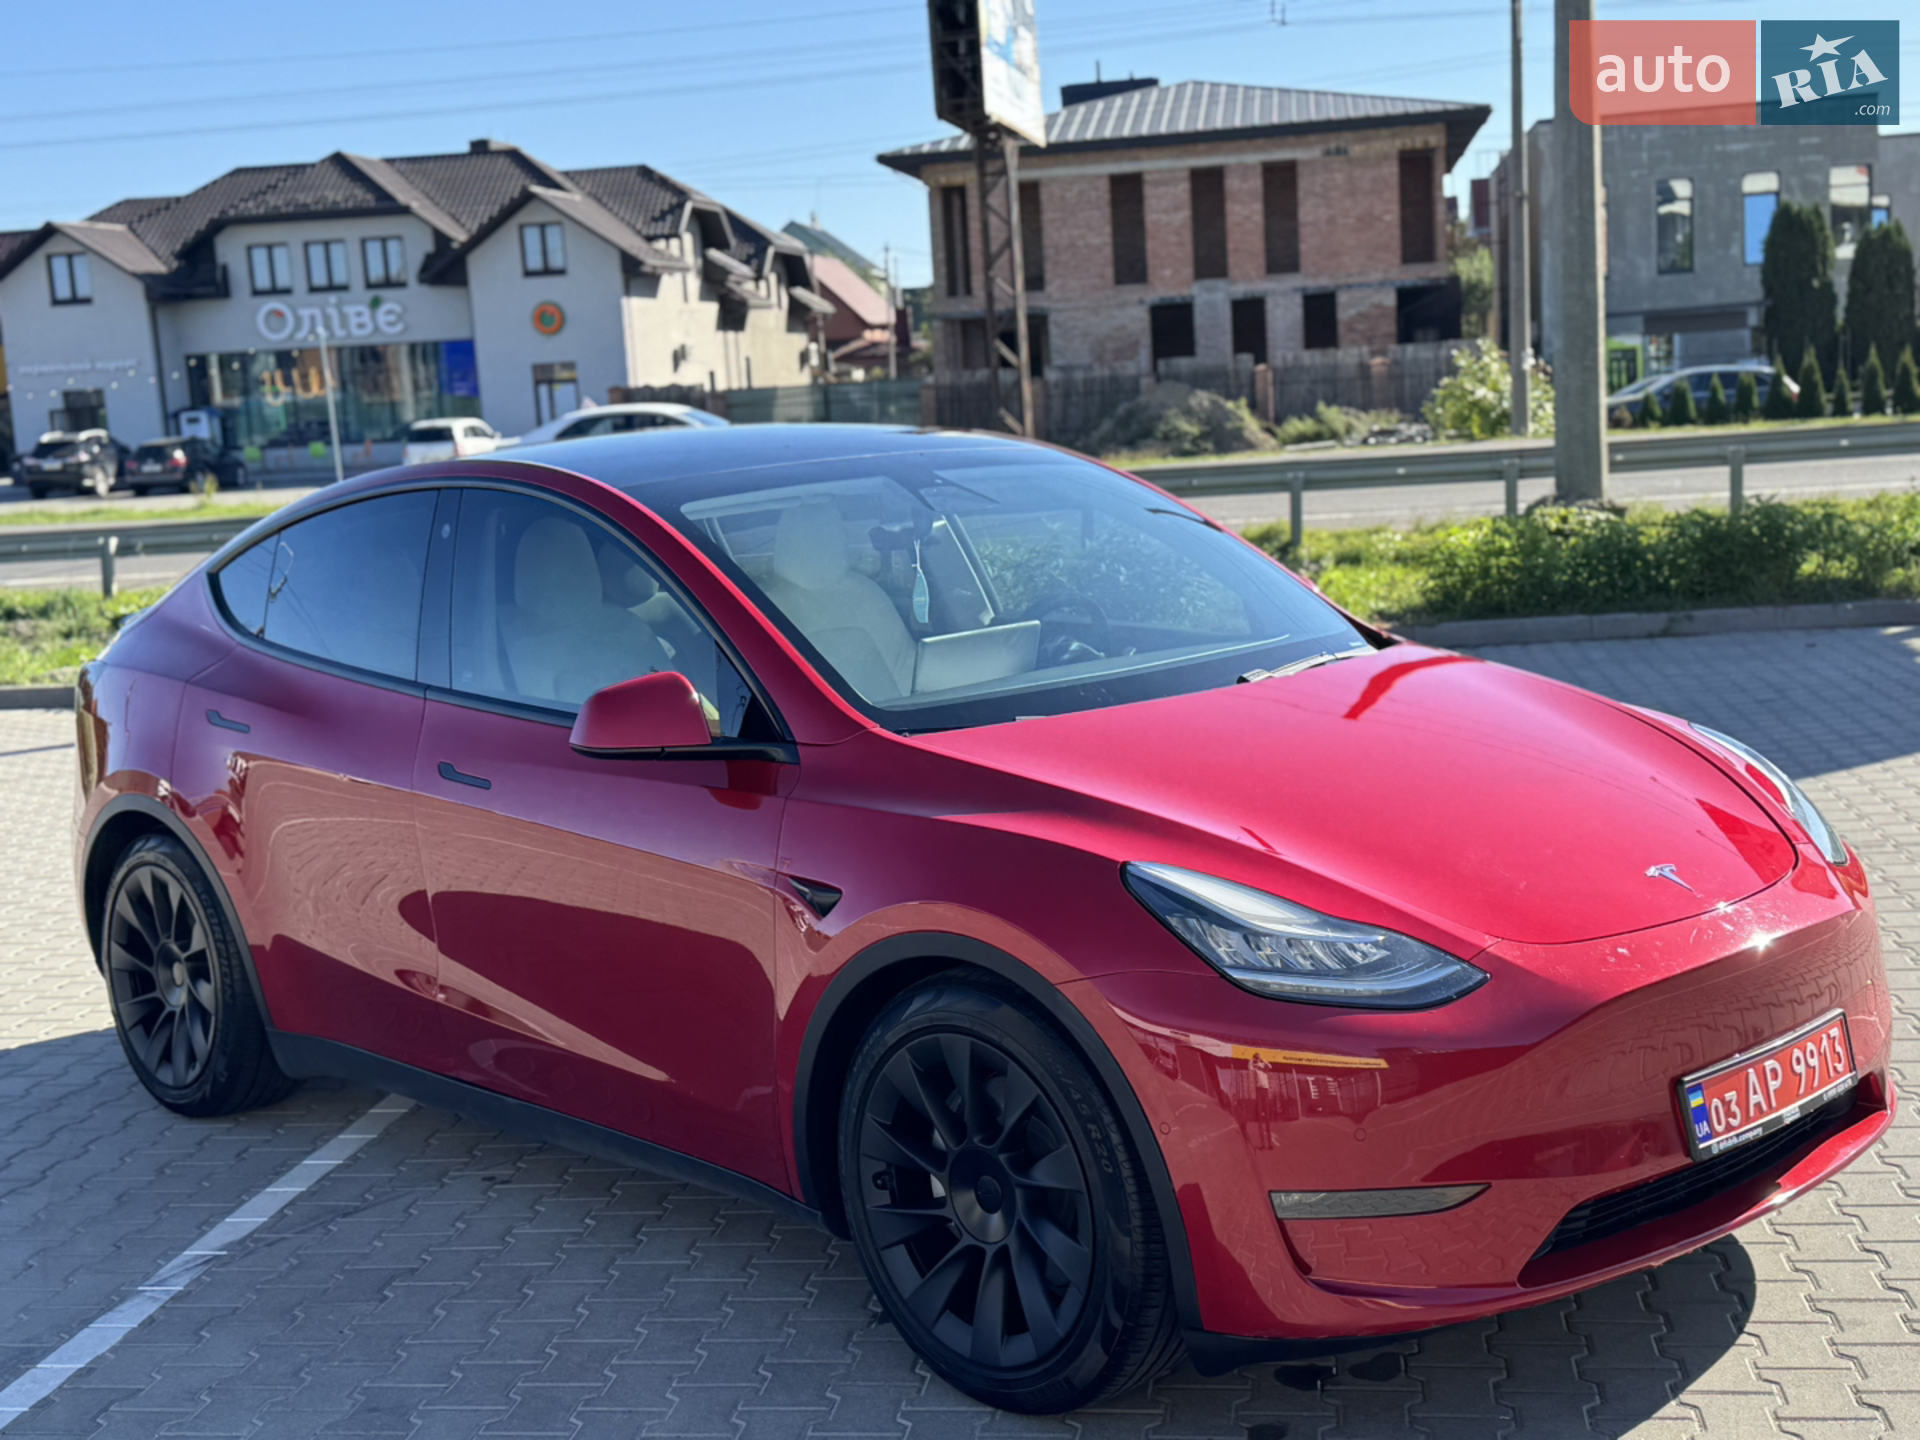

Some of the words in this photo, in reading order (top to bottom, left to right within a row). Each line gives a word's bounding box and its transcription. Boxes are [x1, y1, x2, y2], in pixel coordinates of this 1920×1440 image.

[1710, 1090, 1742, 1133] 03
[1747, 1059, 1783, 1118] AP
[1791, 1027, 1845, 1095] 9913
[1695, 1120, 1711, 1138] UA
